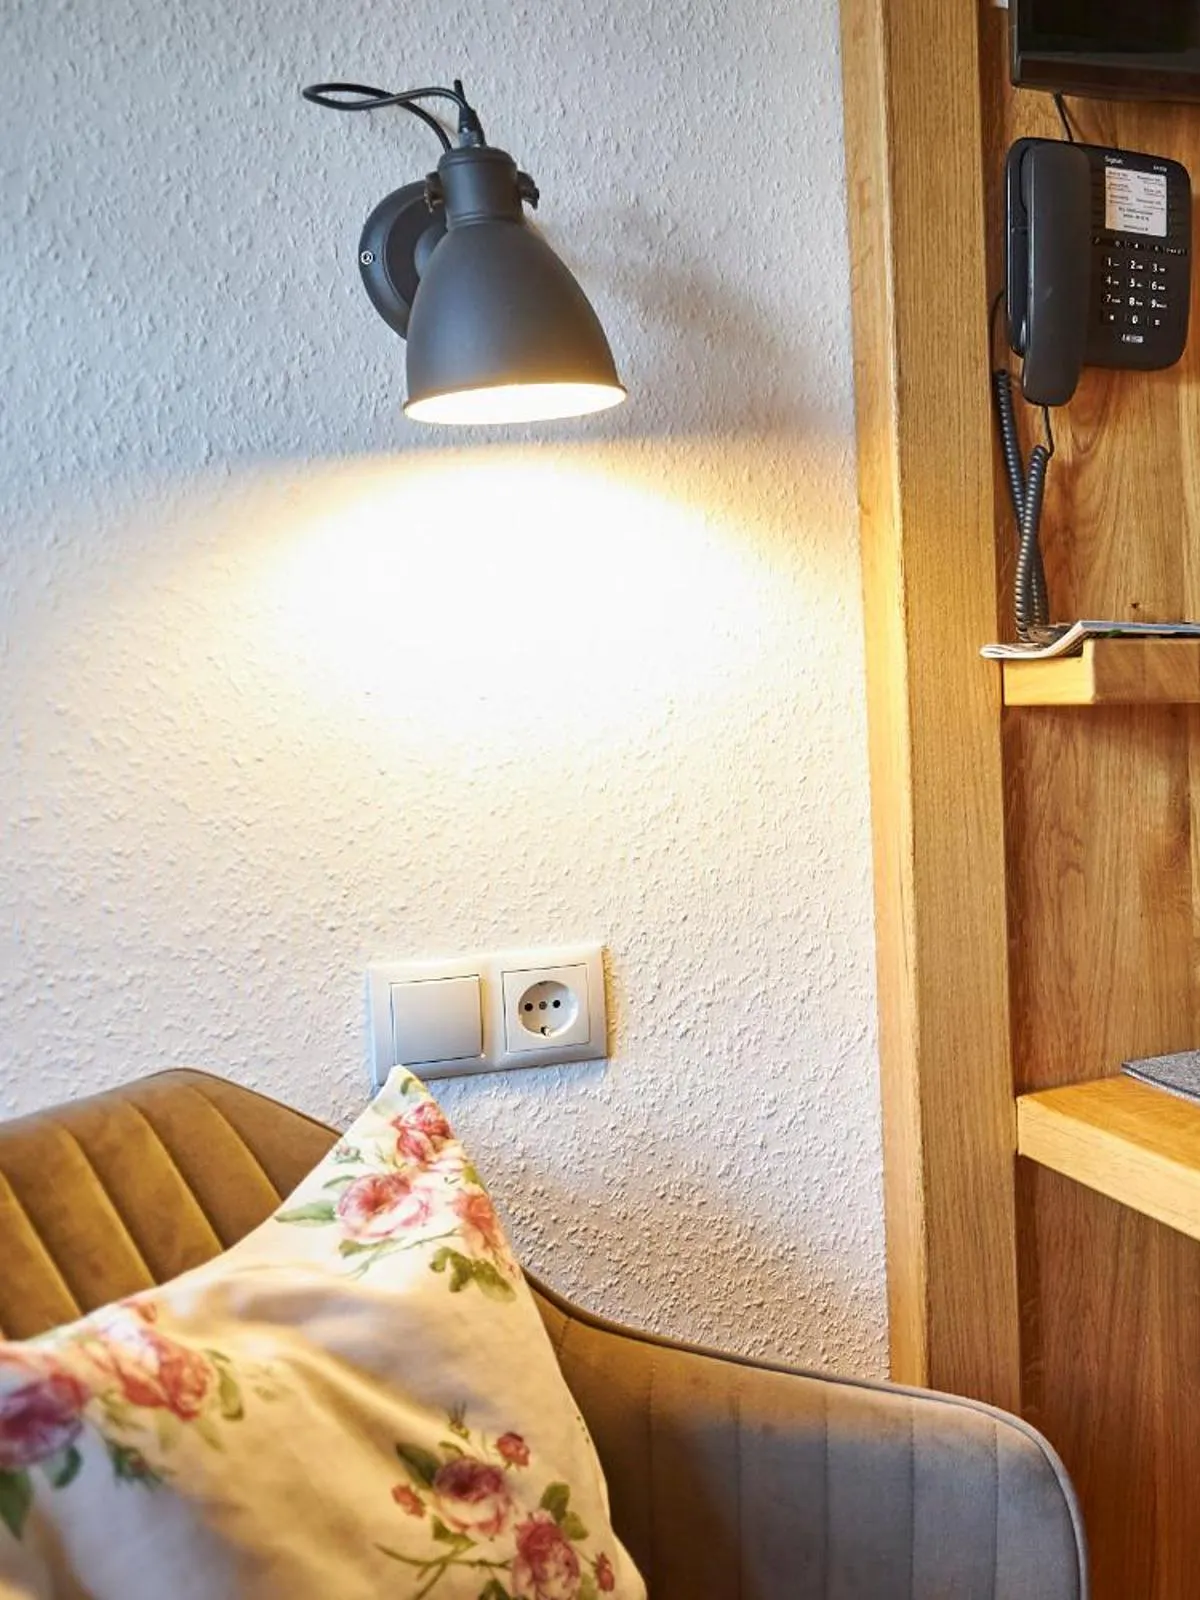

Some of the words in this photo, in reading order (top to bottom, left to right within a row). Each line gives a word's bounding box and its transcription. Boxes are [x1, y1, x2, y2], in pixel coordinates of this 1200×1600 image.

[1130, 260, 1137, 270] 2
[1151, 281, 1158, 291] 6
[1129, 297, 1136, 306] 8
[1132, 315, 1139, 325] 0
